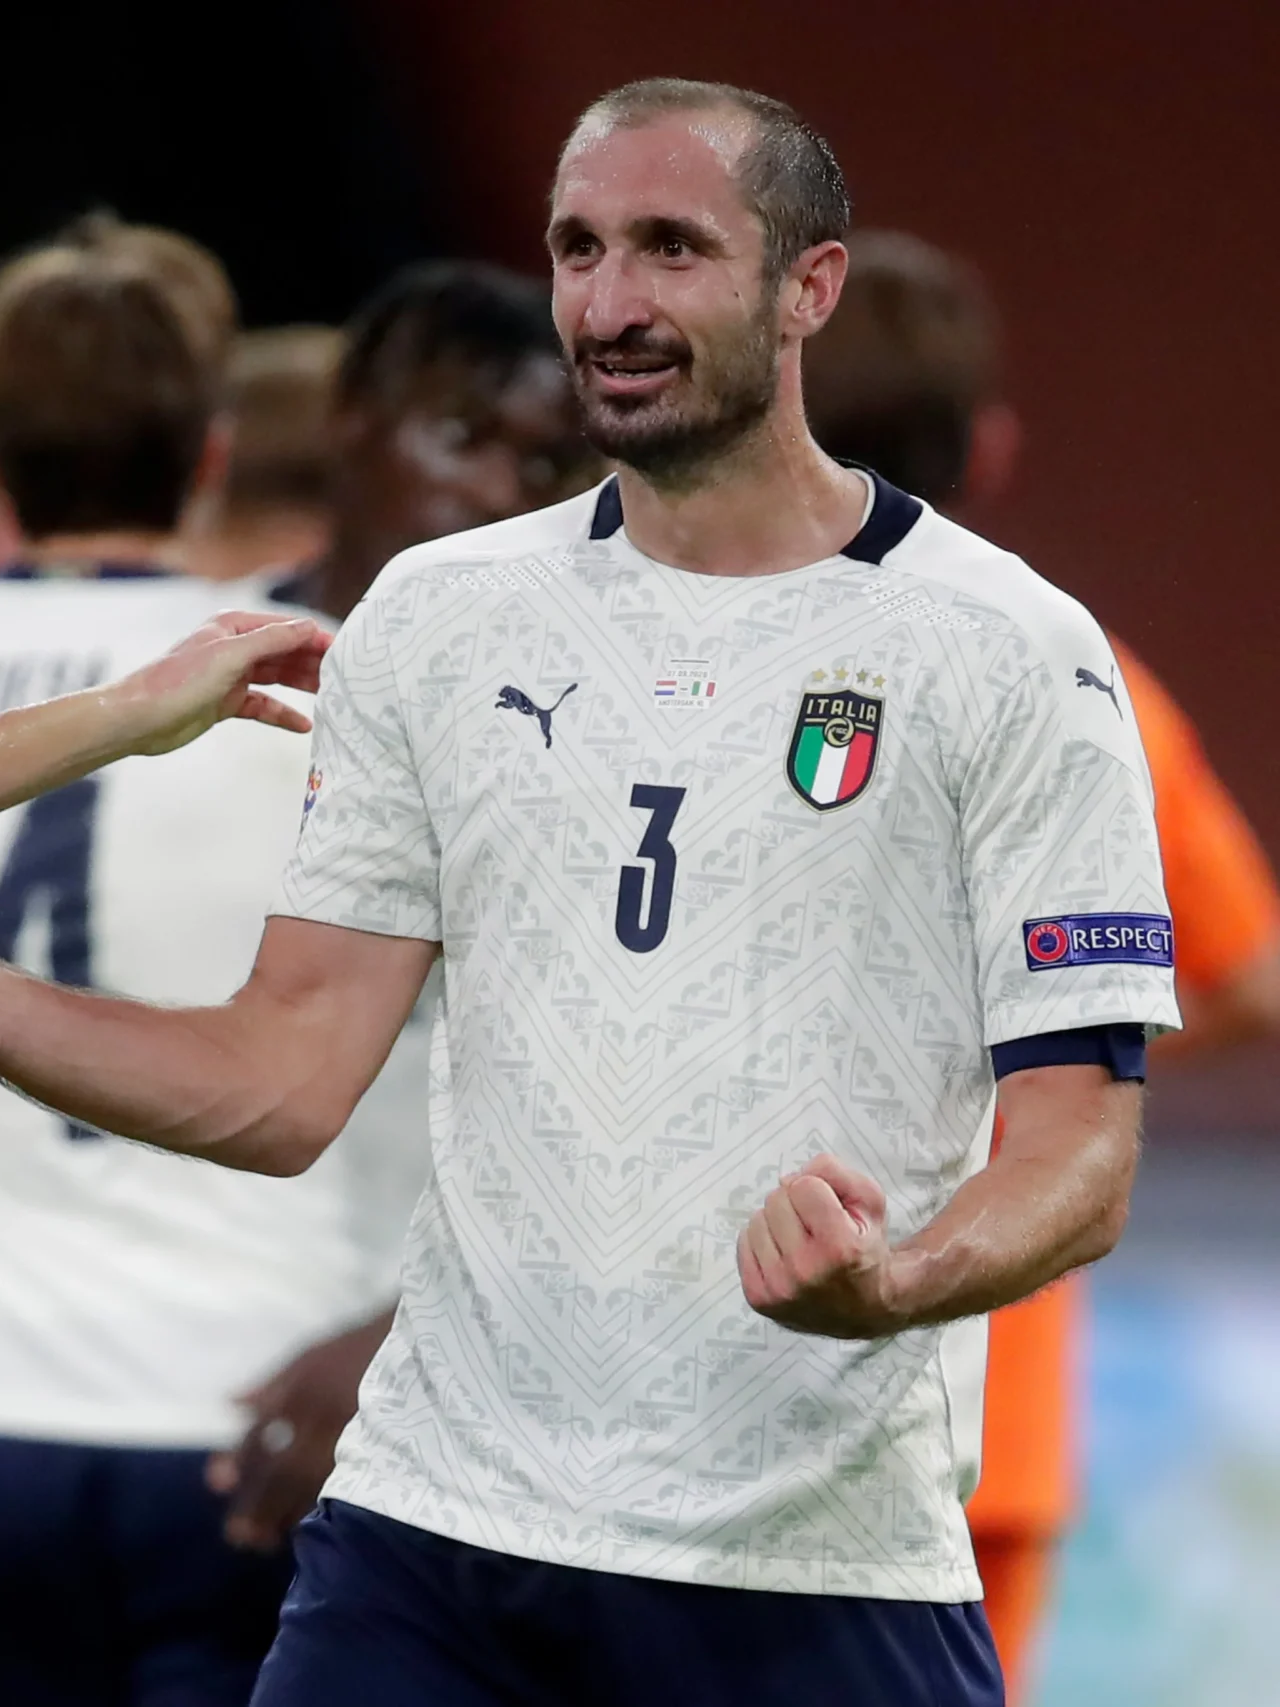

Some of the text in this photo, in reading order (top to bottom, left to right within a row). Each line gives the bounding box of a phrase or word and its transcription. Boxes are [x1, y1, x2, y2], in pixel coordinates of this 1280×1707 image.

[806, 698, 877, 723] ITALIA
[615, 783, 687, 954] 3
[1072, 927, 1172, 952] RESPECT
